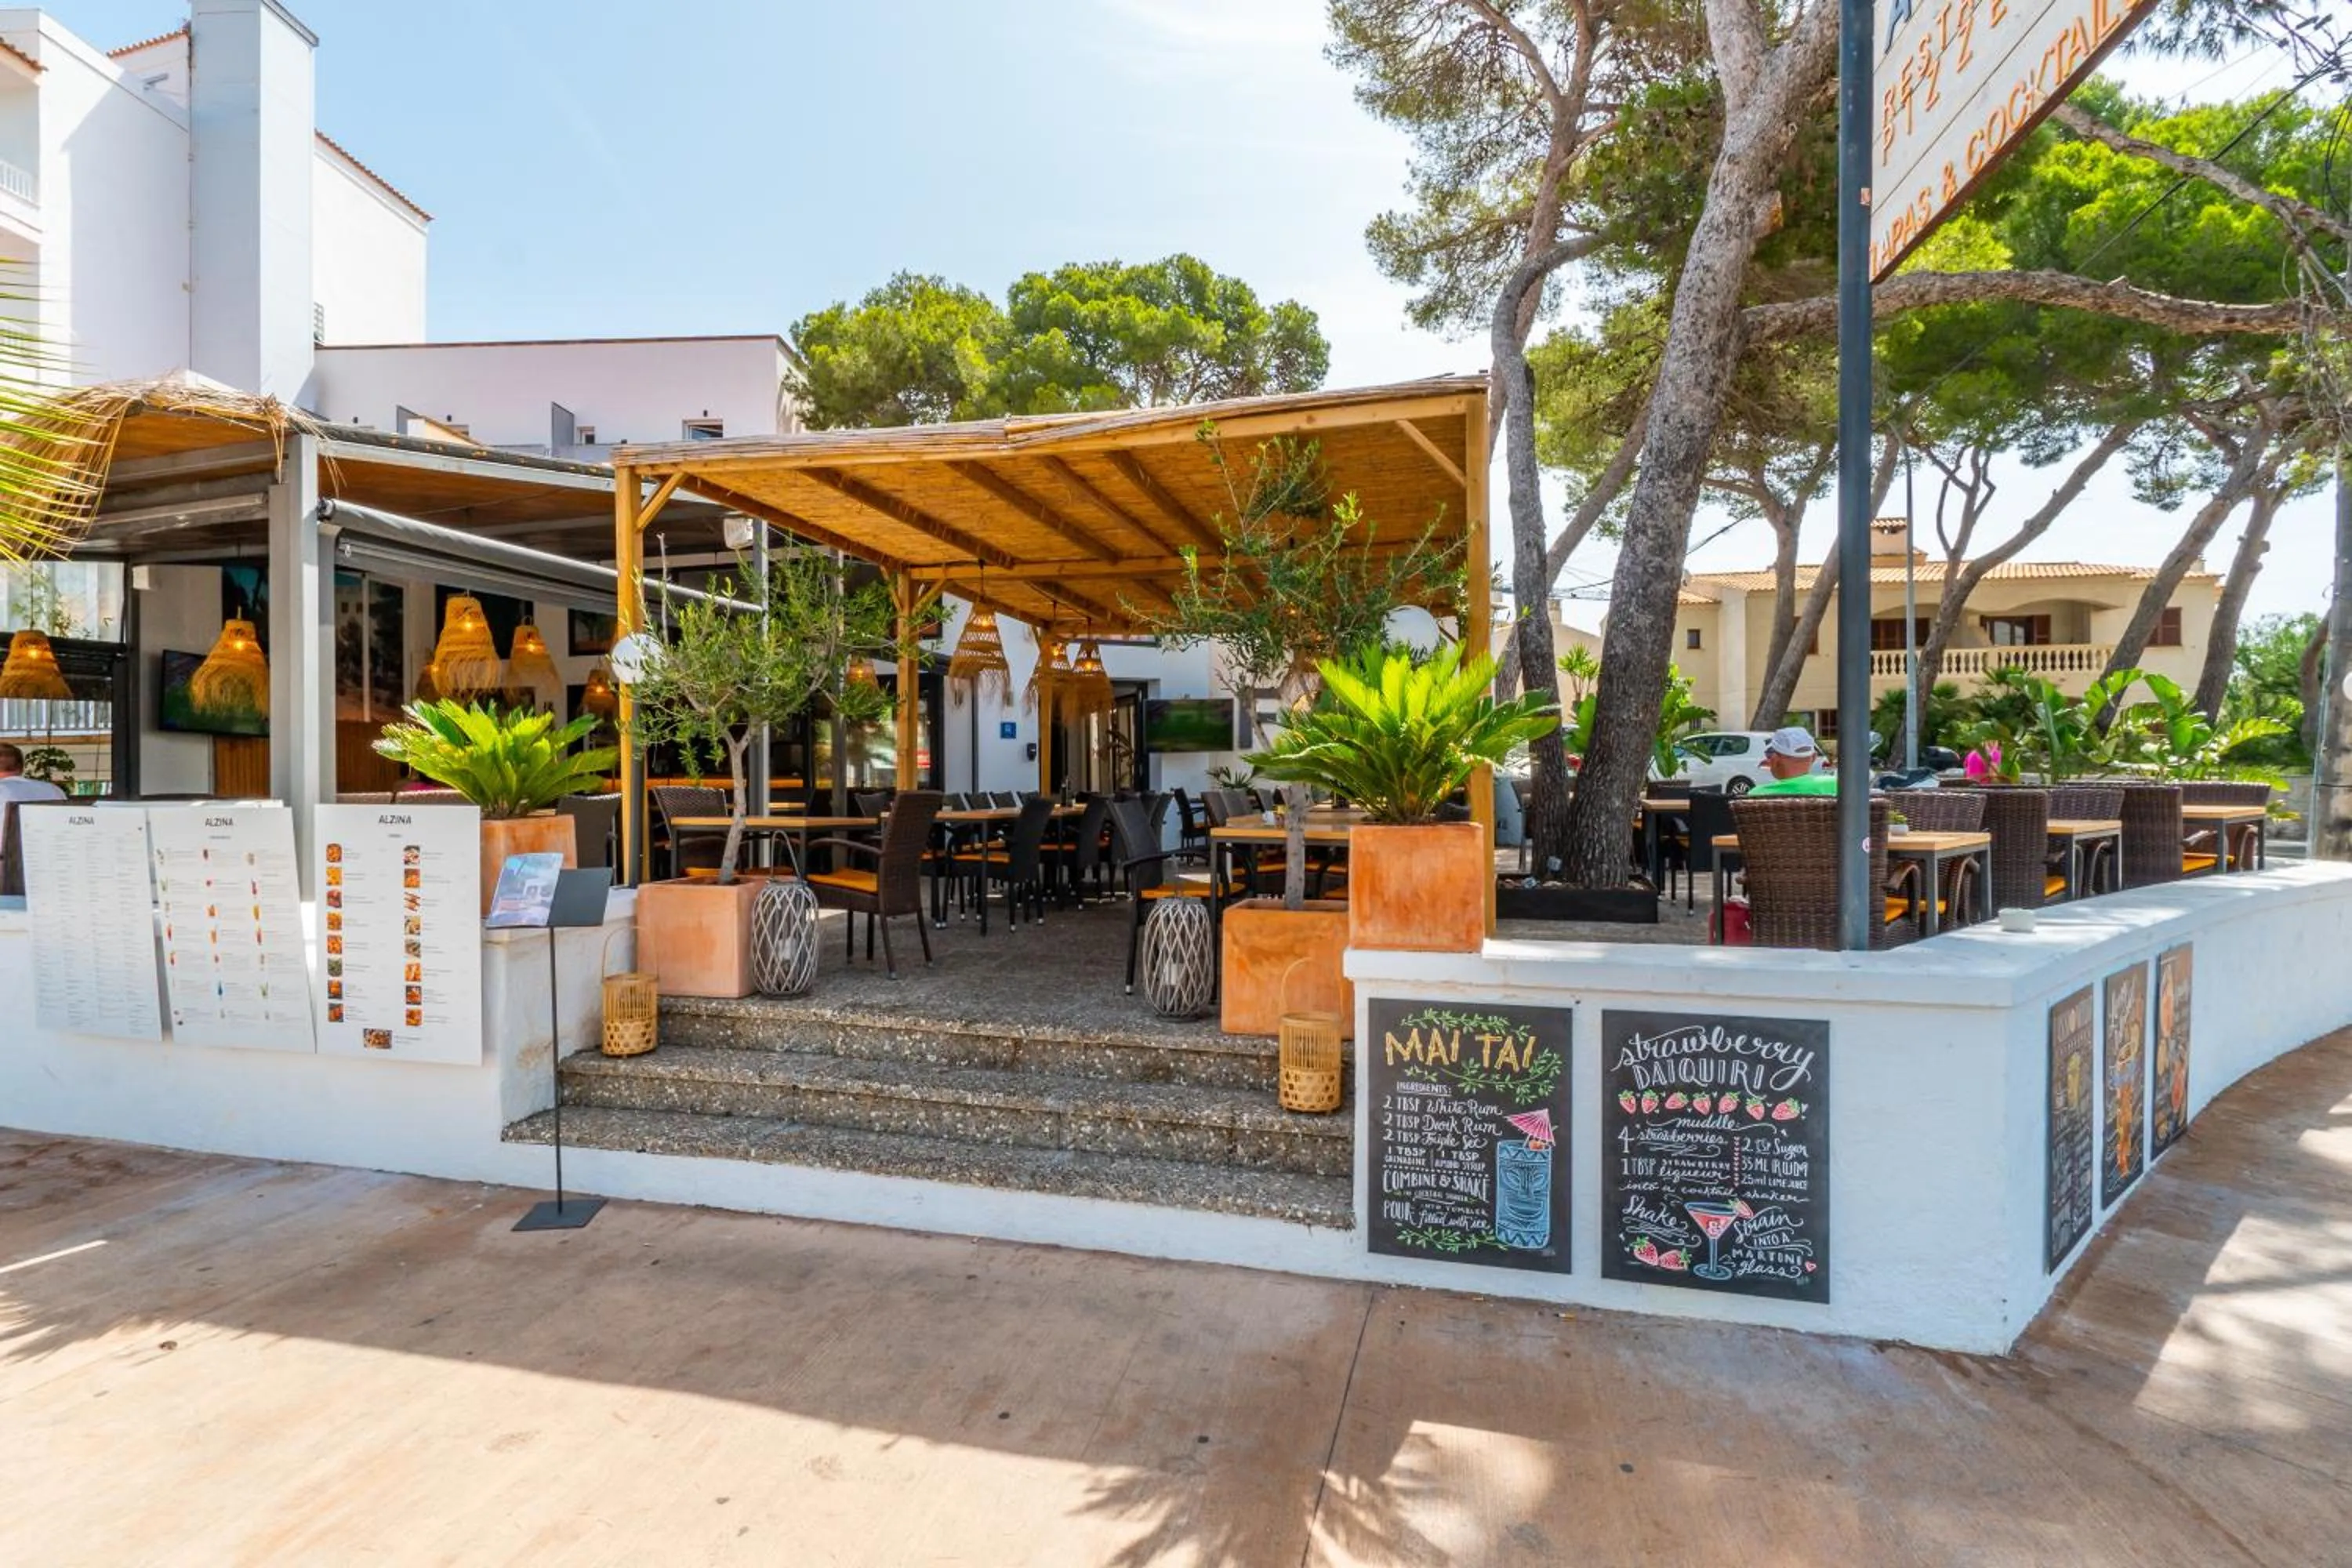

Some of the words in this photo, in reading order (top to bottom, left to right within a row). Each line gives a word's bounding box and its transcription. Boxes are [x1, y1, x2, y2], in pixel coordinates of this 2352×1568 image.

[1966, 0, 2142, 176] COCKTAIL
[69, 816, 94, 825] ALZINA
[205, 818, 234, 826] ALZINA
[379, 815, 412, 824] ALZINA
[1385, 1028, 1460, 1066] MAI
[1475, 1033, 1537, 1073] TAI
[1610, 1025, 1815, 1091] strawberry
[1632, 1058, 1767, 1099] DAIQUIRI
[1383, 1095, 1392, 1109] 2
[1396, 1097, 1420, 1112] TBSP
[1426, 1098, 1467, 1115] White
[1467, 1099, 1503, 1120] Rum
[1383, 1112, 1392, 1126] 2
[1396, 1114, 1420, 1129] TBSP
[1462, 1116, 1503, 1137] Rum
[1383, 1129, 1394, 1142] 2
[1397, 1130, 1420, 1145] TBSP
[1396, 1146, 1426, 1156] TBSP
[1617, 1126, 1635, 1153] 4
[1741, 1136, 1753, 1152] 2
[1621, 1158, 1630, 1175] 1
[1772, 1159, 1809, 1178] RUM
[1383, 1169, 1437, 1192] COMBINE
[1452, 1175, 1490, 1203] SHAKE
[1384, 1200, 1415, 1225] POUR
[1621, 1194, 1678, 1227] Shake
[1732, 1248, 1802, 1265] MARTINI
